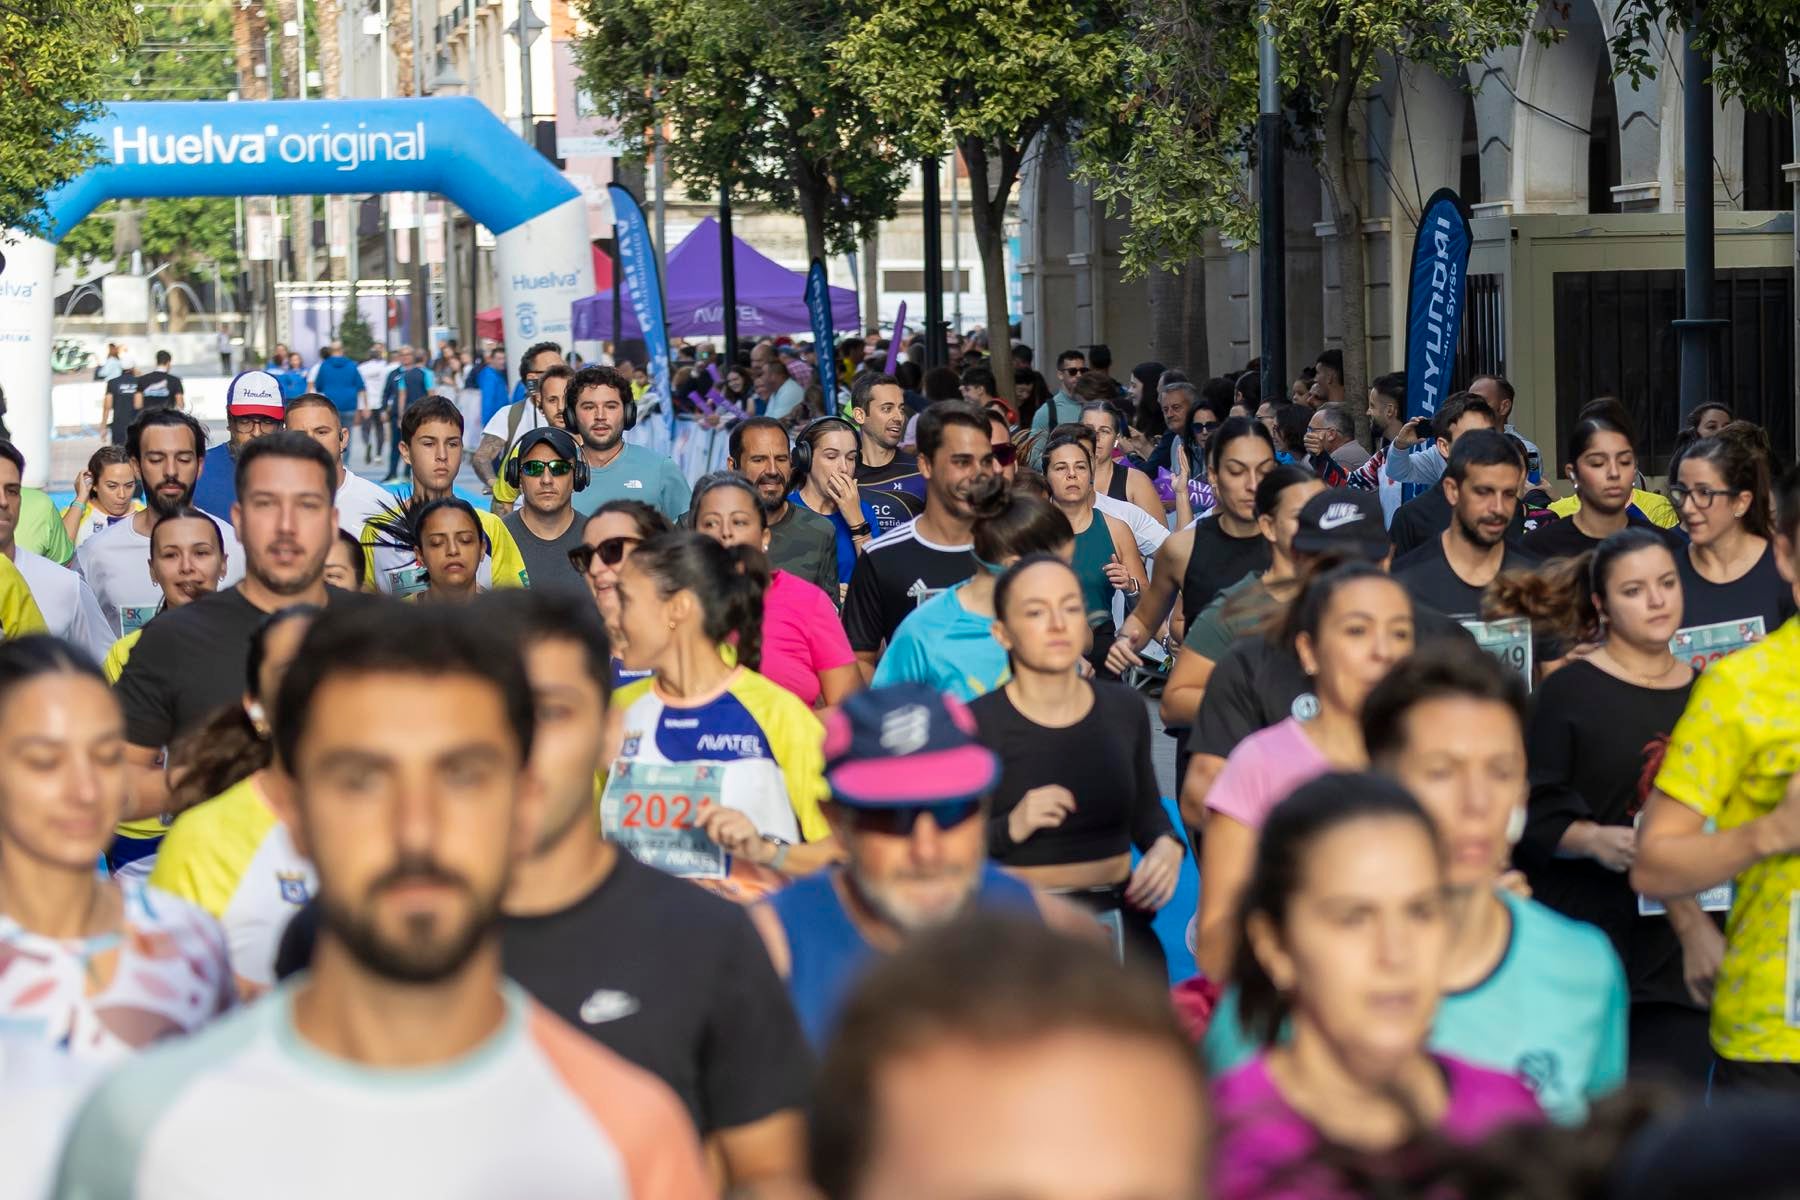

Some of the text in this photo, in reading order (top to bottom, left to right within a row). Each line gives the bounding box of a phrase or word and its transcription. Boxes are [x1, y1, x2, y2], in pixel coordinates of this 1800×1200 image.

[113, 121, 425, 171] Huelva original
[512, 271, 577, 291] Huelva
[1422, 216, 1450, 414] HYUNDAI
[243, 388, 272, 399] Houston
[1327, 503, 1359, 518] NIKE
[126, 607, 142, 620] 5K
[697, 734, 763, 754] AVATEL
